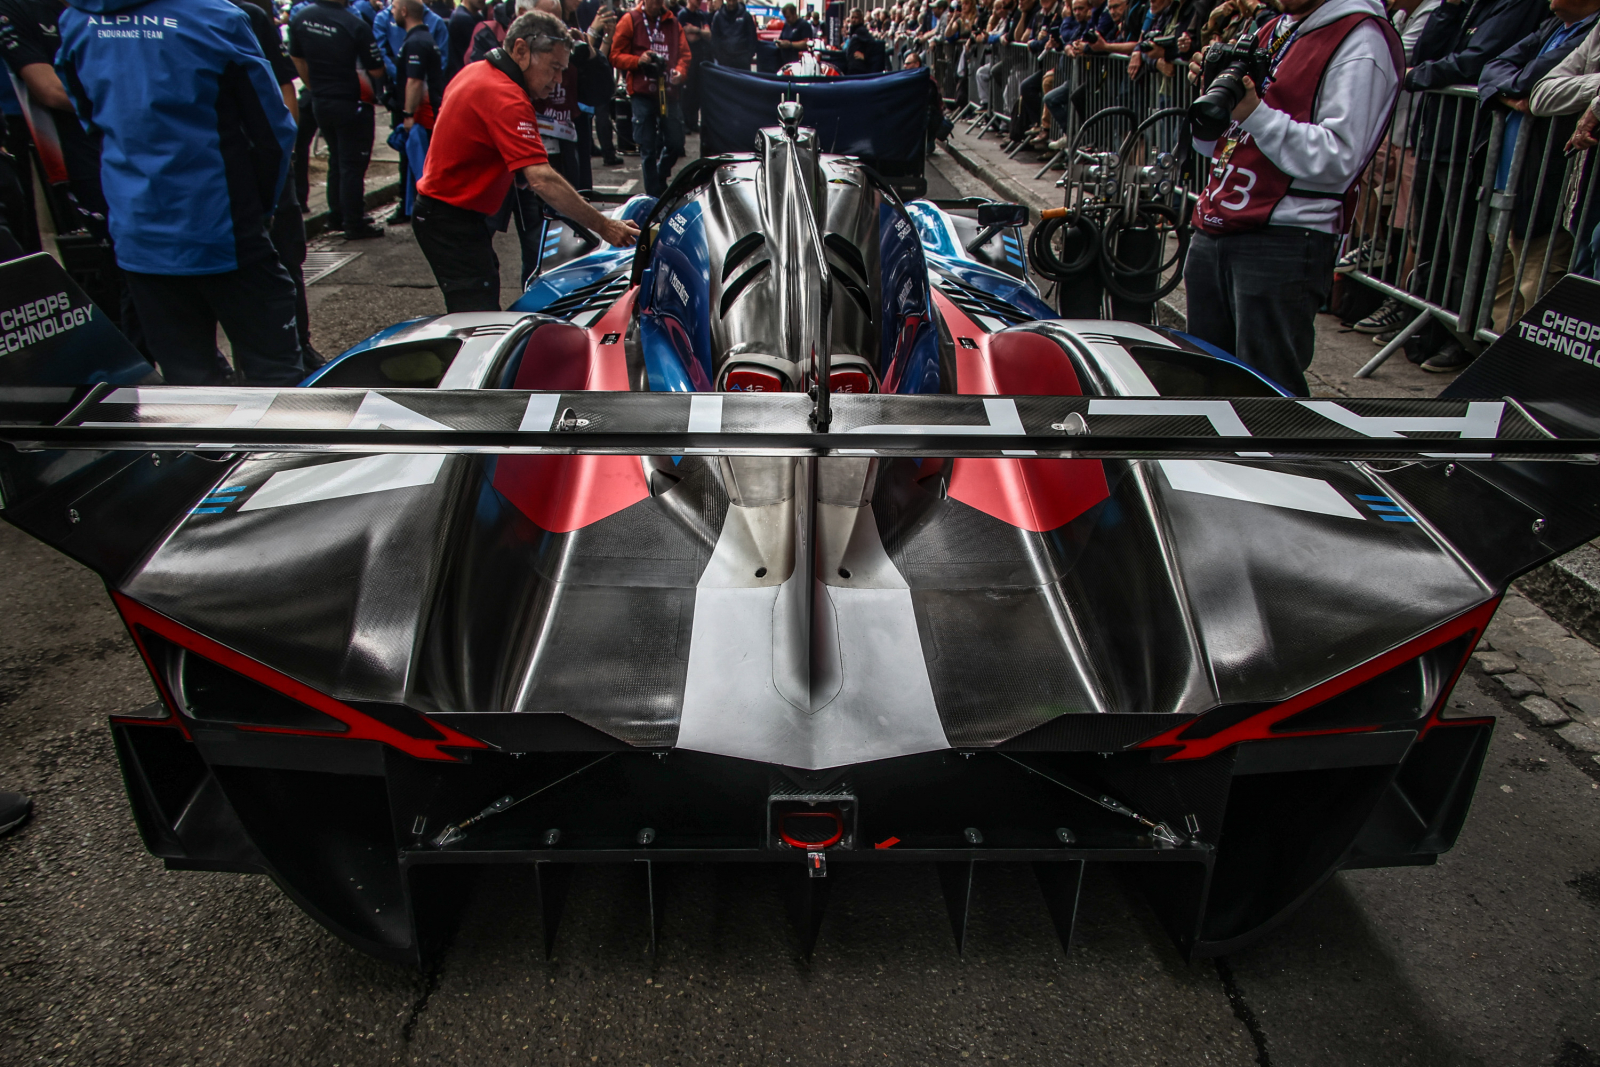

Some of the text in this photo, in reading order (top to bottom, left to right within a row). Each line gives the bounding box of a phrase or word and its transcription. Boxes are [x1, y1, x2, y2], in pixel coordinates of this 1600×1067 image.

[87, 15, 178, 28] ALPINE
[302, 20, 337, 33] ALPINE
[97, 29, 164, 40] ENDURANCE TEAM
[0, 291, 70, 331] CHEOPS
